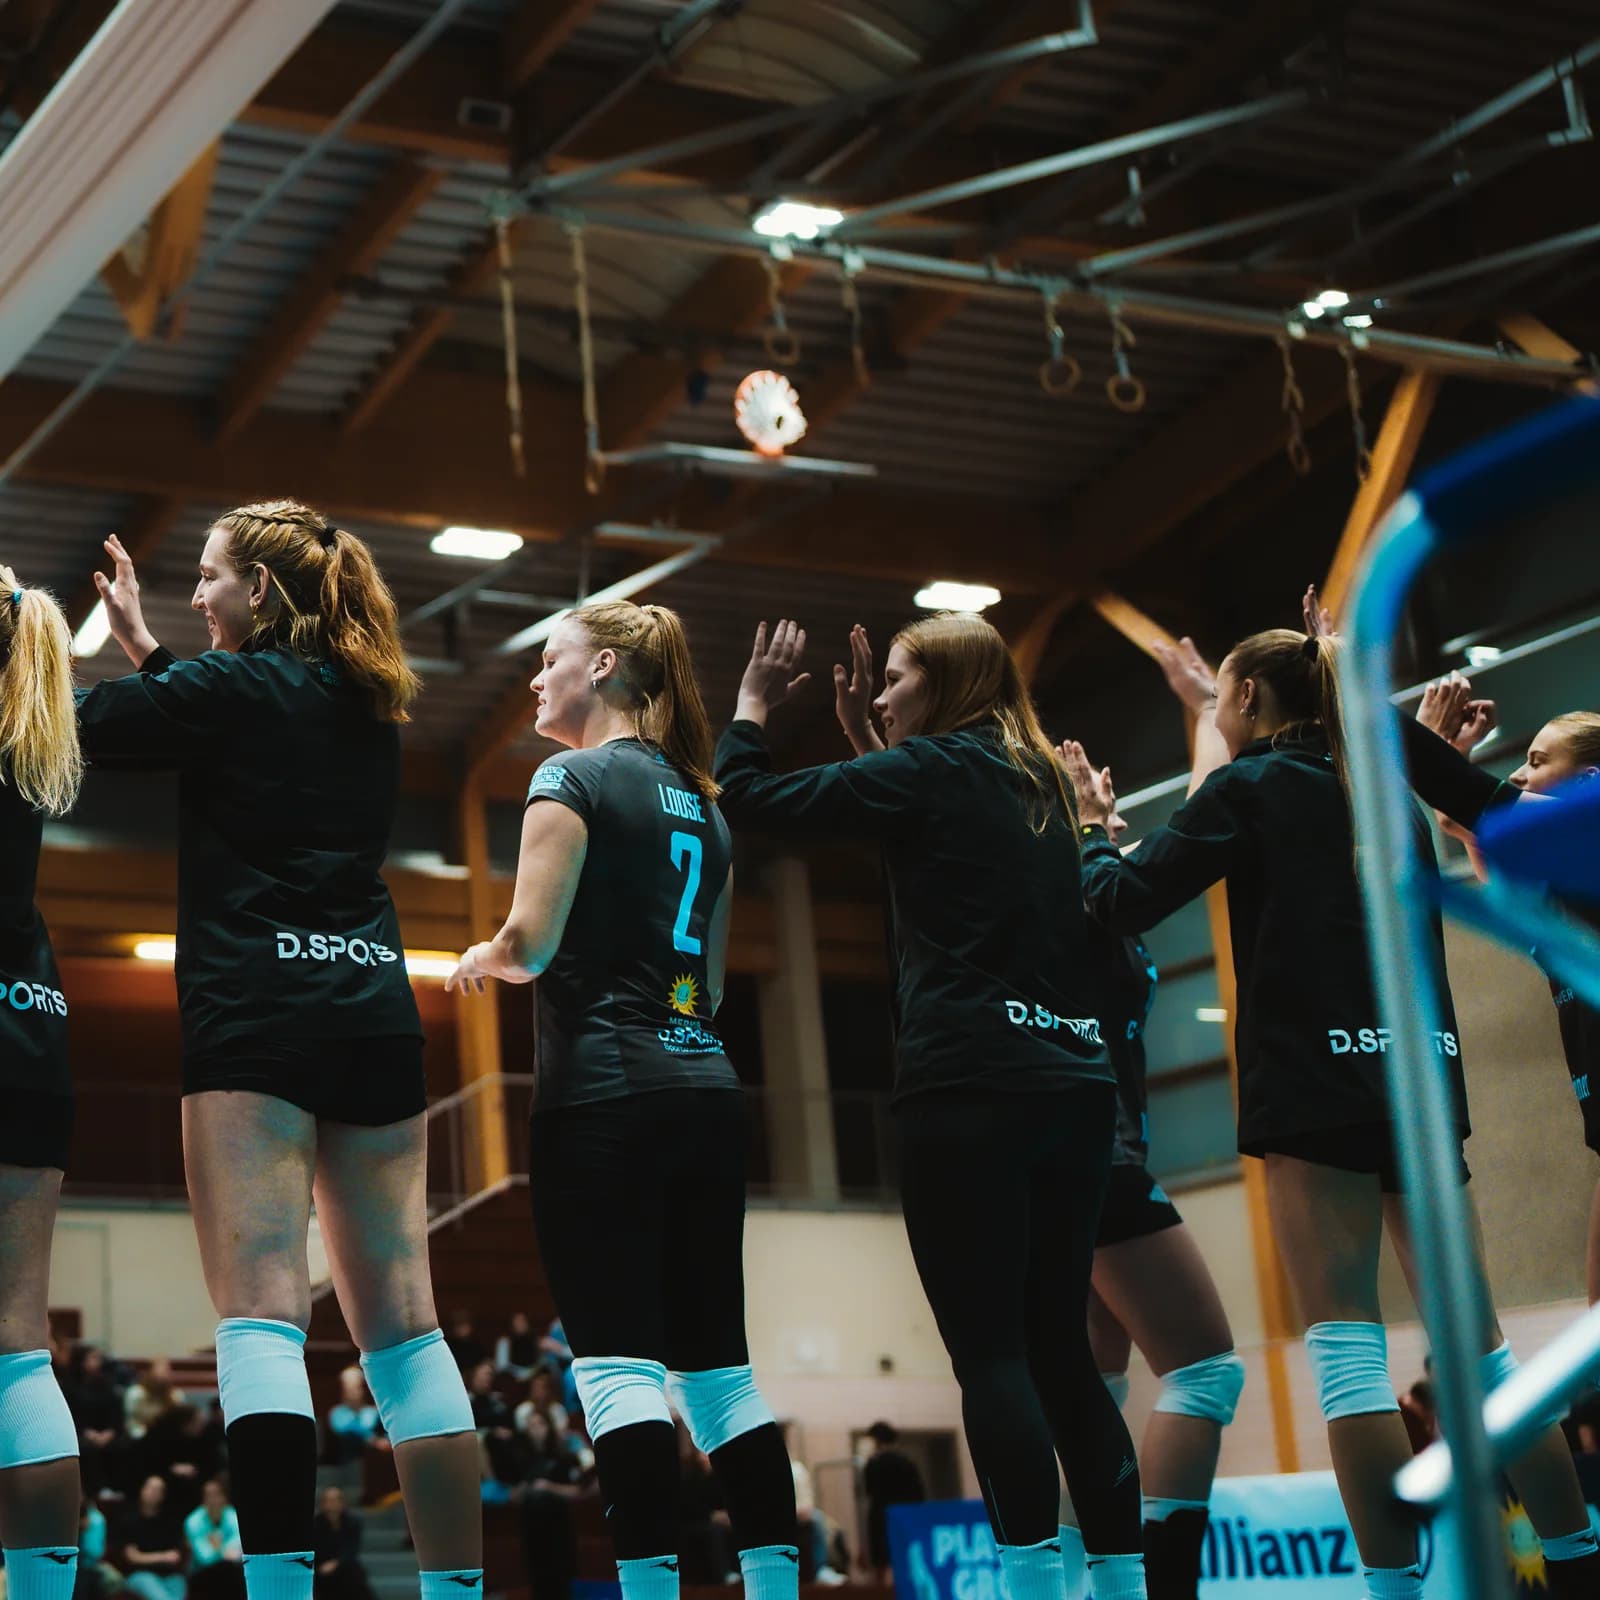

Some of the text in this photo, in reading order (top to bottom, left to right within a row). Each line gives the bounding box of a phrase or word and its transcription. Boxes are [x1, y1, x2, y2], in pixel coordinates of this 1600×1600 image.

[657, 783, 706, 824] LOOSE
[670, 830, 702, 956] 2
[1328, 1028, 1458, 1057] D.SPTS
[1201, 1516, 1354, 1583] llianz
